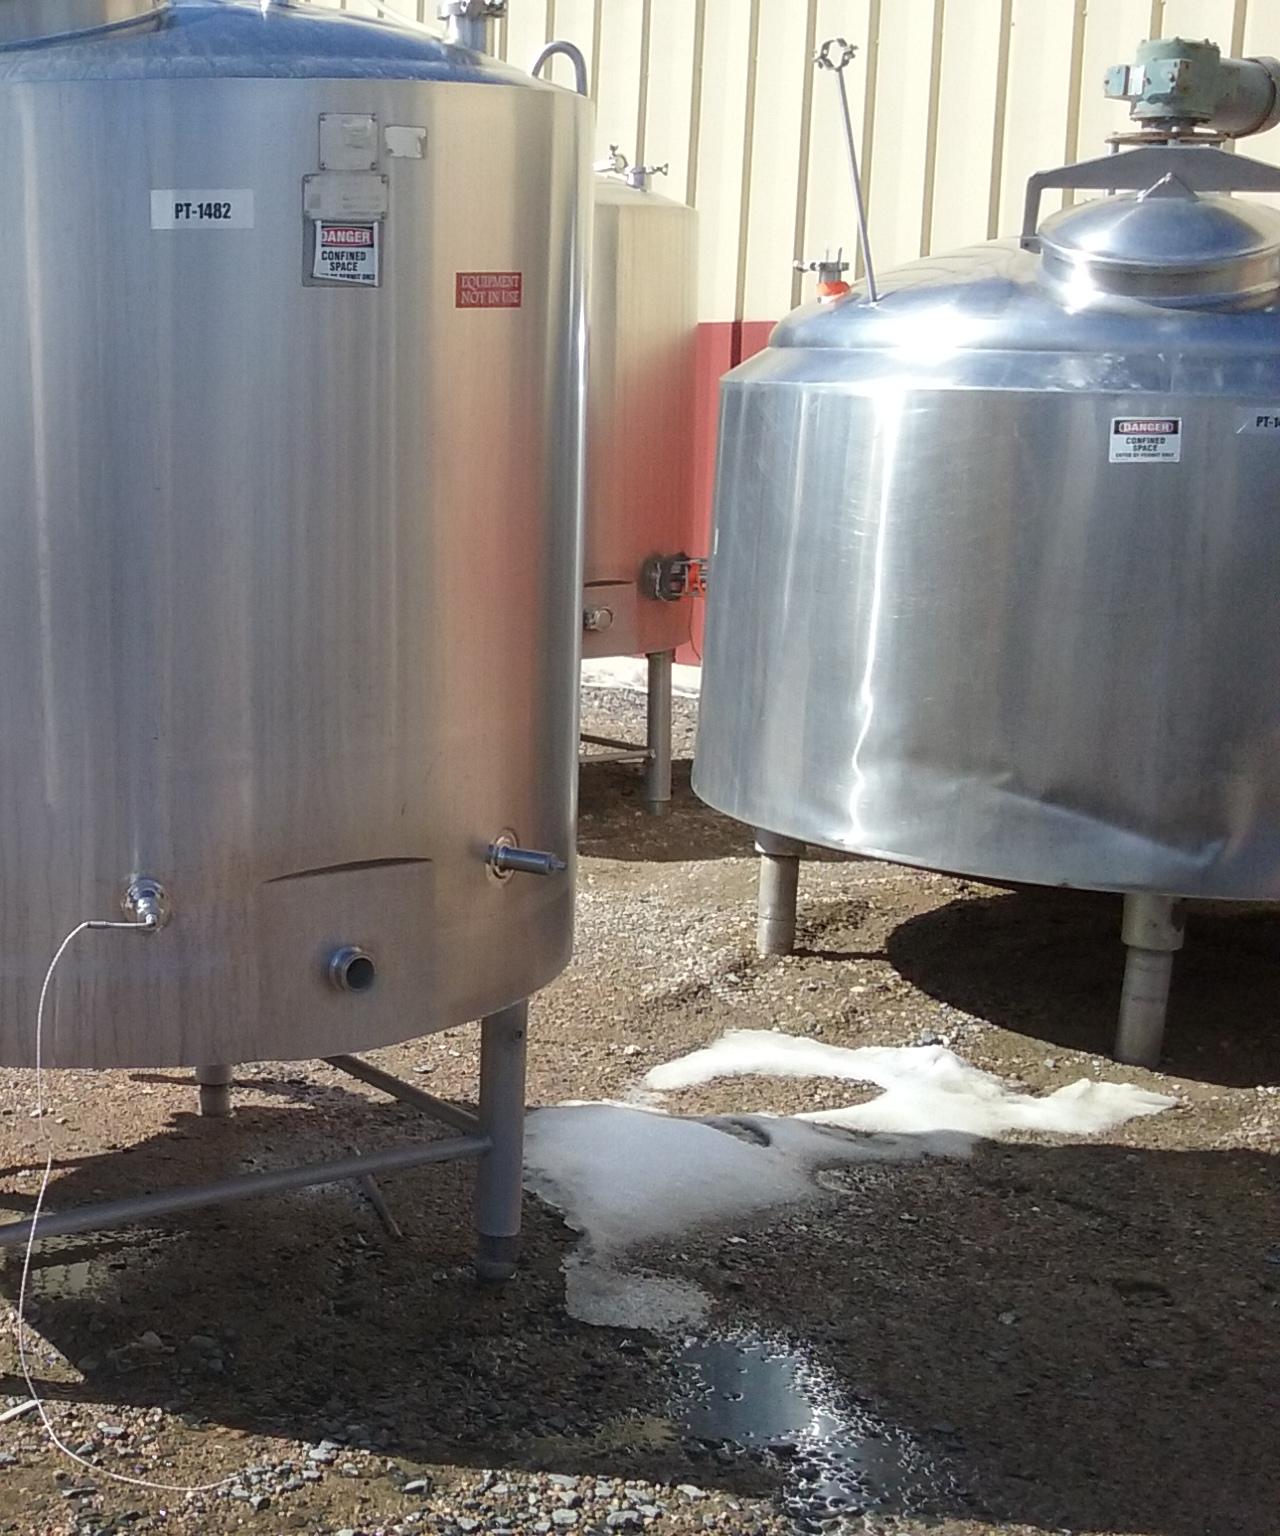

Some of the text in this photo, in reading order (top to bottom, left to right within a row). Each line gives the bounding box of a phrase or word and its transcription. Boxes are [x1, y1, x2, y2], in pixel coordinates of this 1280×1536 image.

[174, 202, 232, 219] PT-1482
[321, 230, 371, 243] DANGER
[321, 250, 367, 261] CONFINED
[329, 261, 358, 272] SPACE
[461, 275, 519, 290] EQUIPMENT
[461, 290, 520, 304] NOT IN USE
[1123, 422, 1170, 431] DANGER
[1255, 415, 1280, 428] PT-1
[1125, 437, 1166, 445] CONFINED
[1132, 444, 1158, 452] SPACE
